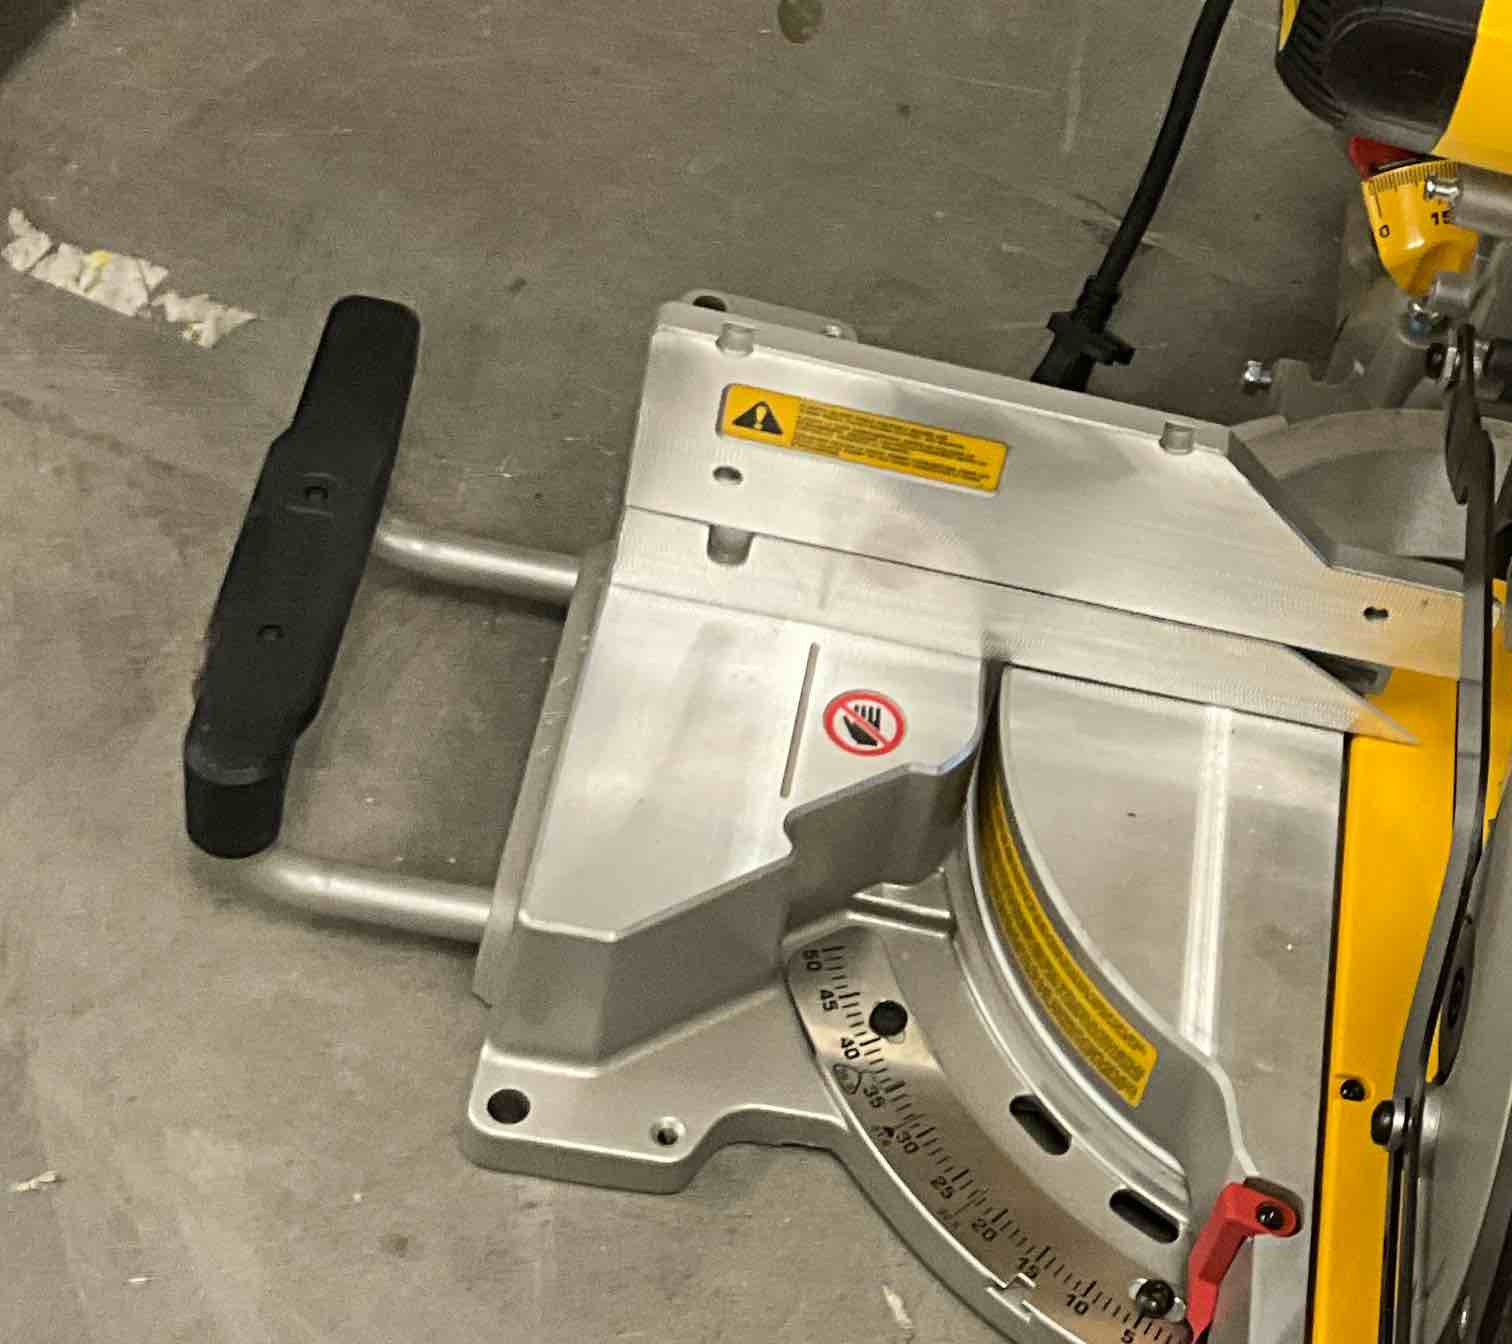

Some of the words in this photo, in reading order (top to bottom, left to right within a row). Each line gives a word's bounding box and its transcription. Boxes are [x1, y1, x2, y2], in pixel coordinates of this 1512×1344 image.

[820, 989, 839, 1012] 45
[930, 1175, 953, 1199] 25
[971, 1218, 997, 1241] 20
[1066, 1293, 1089, 1316] 10
[1121, 1328, 1136, 1344] 5
